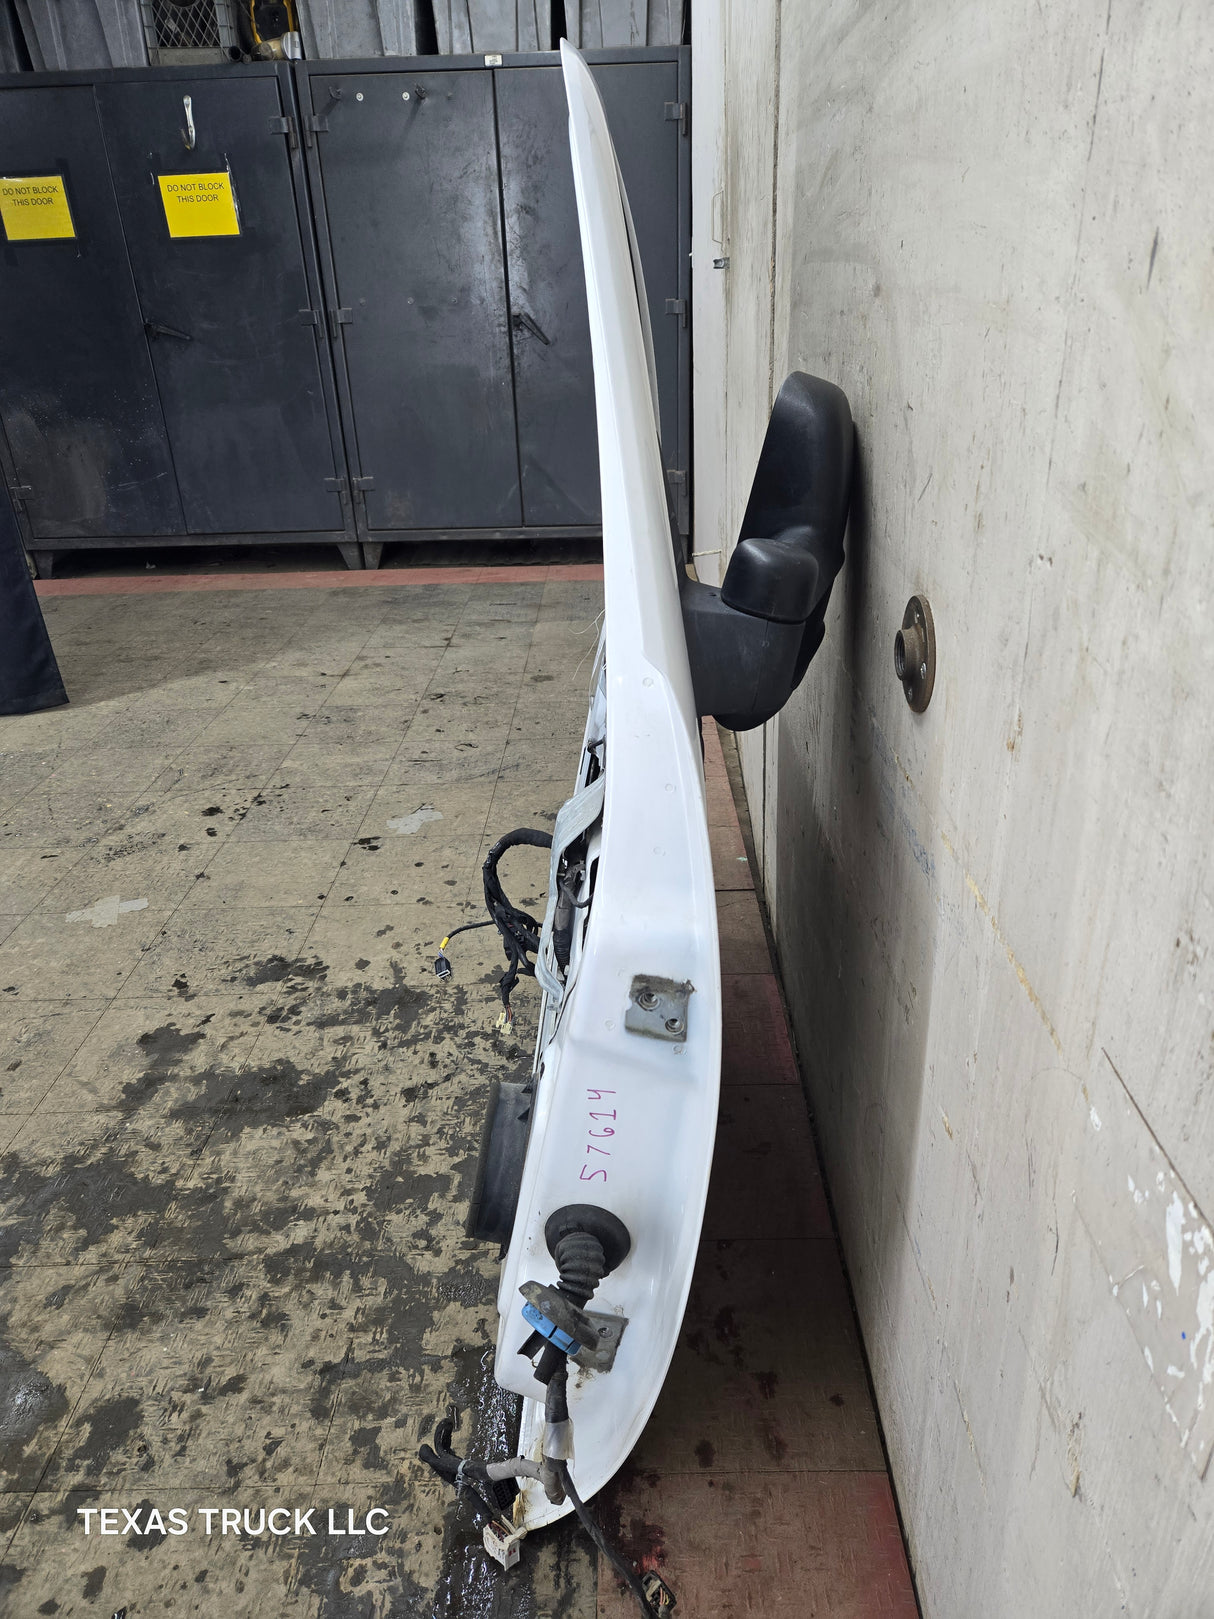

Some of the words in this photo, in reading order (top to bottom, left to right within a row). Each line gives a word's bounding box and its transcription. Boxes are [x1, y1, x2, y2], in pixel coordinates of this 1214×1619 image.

[2, 187, 14, 196] DO
[15, 186, 31, 195] NOT
[32, 185, 58, 194] BLOCK
[167, 184, 178, 192] DO
[180, 183, 196, 191] NOT
[198, 182, 225, 191] BLOCK
[13, 198, 30, 206] THIS
[31, 197, 54, 206] DOOR
[176, 195, 194, 203] THIS
[196, 194, 218, 202] DOOR
[579, 1088, 617, 1182] 57614
